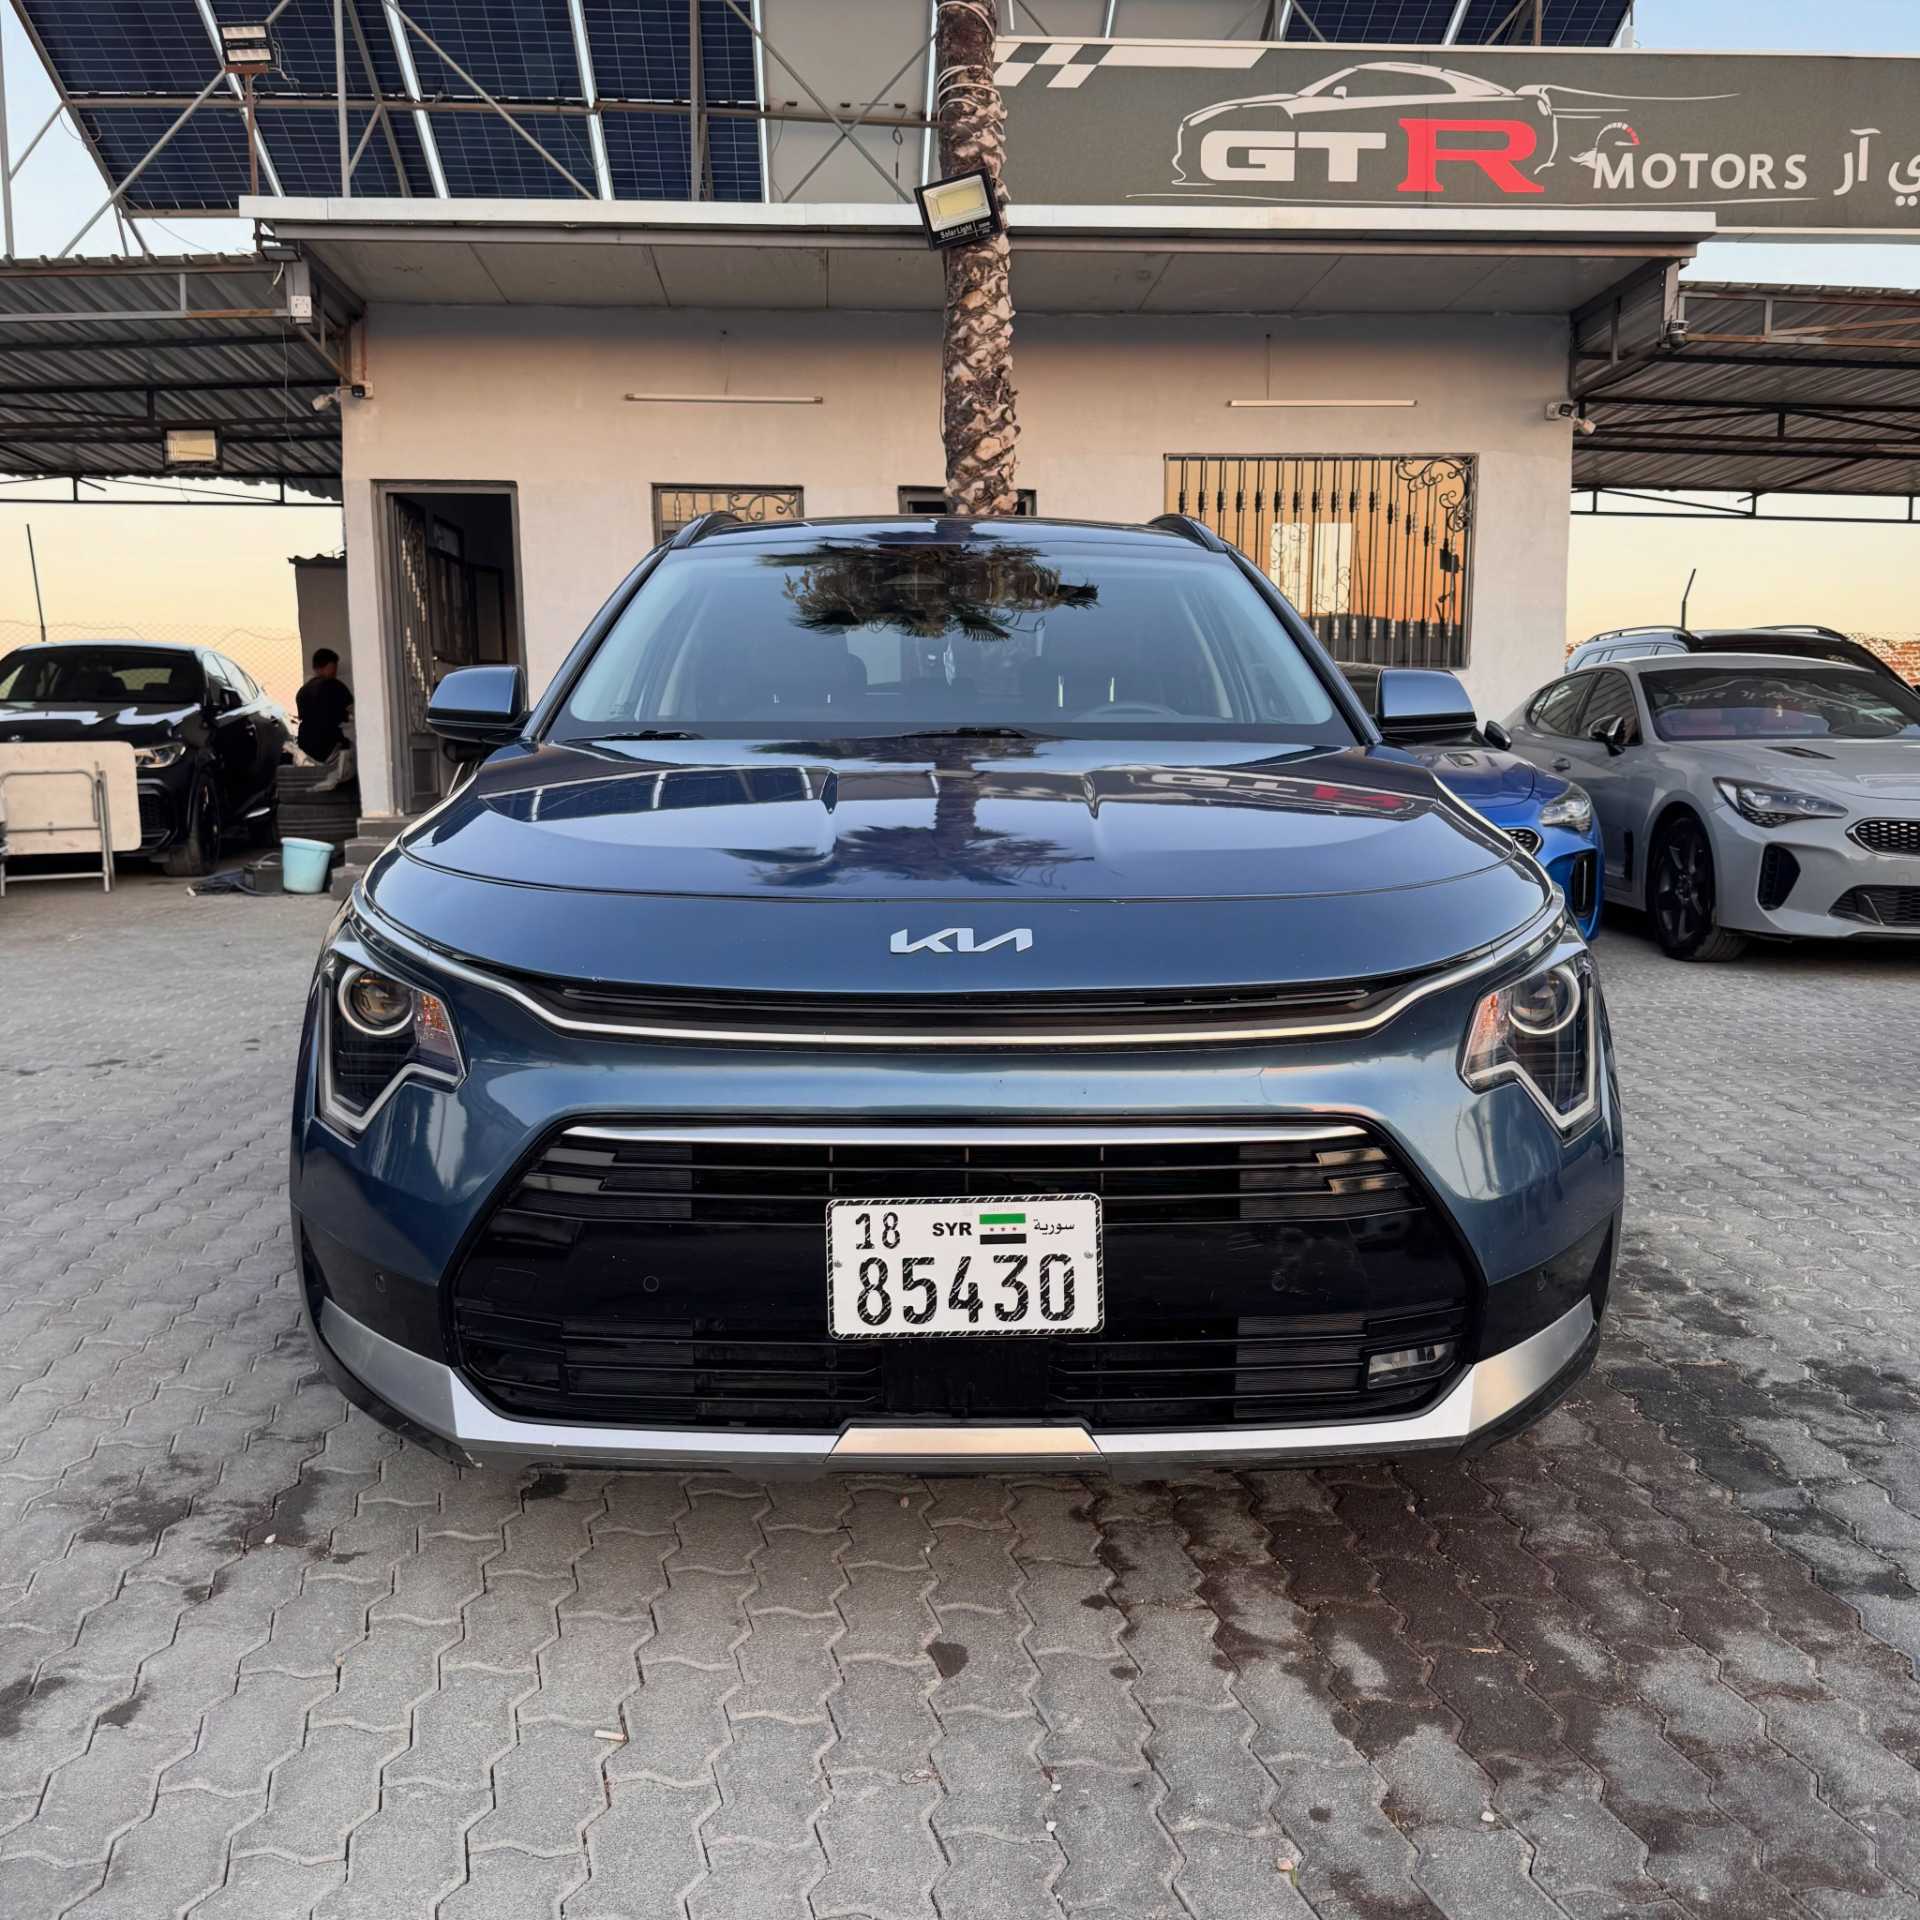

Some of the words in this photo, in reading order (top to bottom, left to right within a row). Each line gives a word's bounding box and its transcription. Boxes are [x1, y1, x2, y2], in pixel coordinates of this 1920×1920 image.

[1199, 117, 1546, 194] GTR
[1592, 152, 1808, 190] MOTORS
[1832, 127, 1882, 196] آر
[855, 1211, 901, 1250] 18
[932, 1221, 973, 1237] SYR
[1033, 1219, 1075, 1236] سورية
[857, 1253, 1076, 1326] 85430
